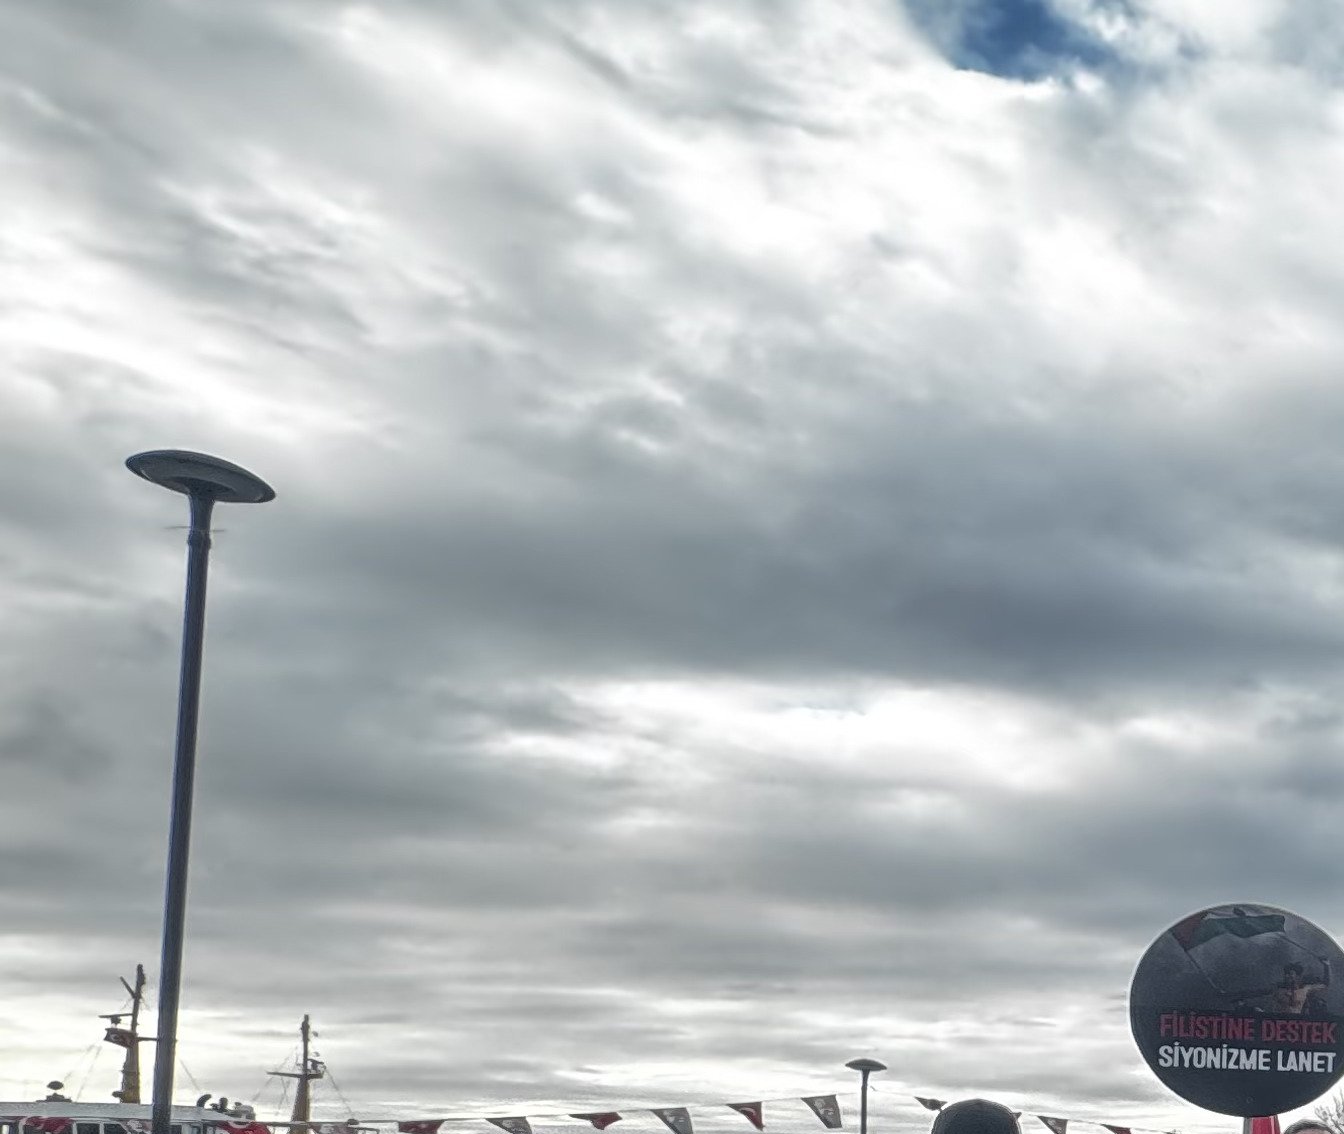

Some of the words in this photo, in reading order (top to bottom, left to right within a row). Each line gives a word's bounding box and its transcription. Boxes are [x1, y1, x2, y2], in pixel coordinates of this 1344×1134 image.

[1159, 1010, 1255, 1041] FİLİSTİNE
[1260, 1018, 1337, 1045] DESTEK
[1158, 1041, 1272, 1071] SİYONİZME
[1276, 1050, 1337, 1074] LANET
